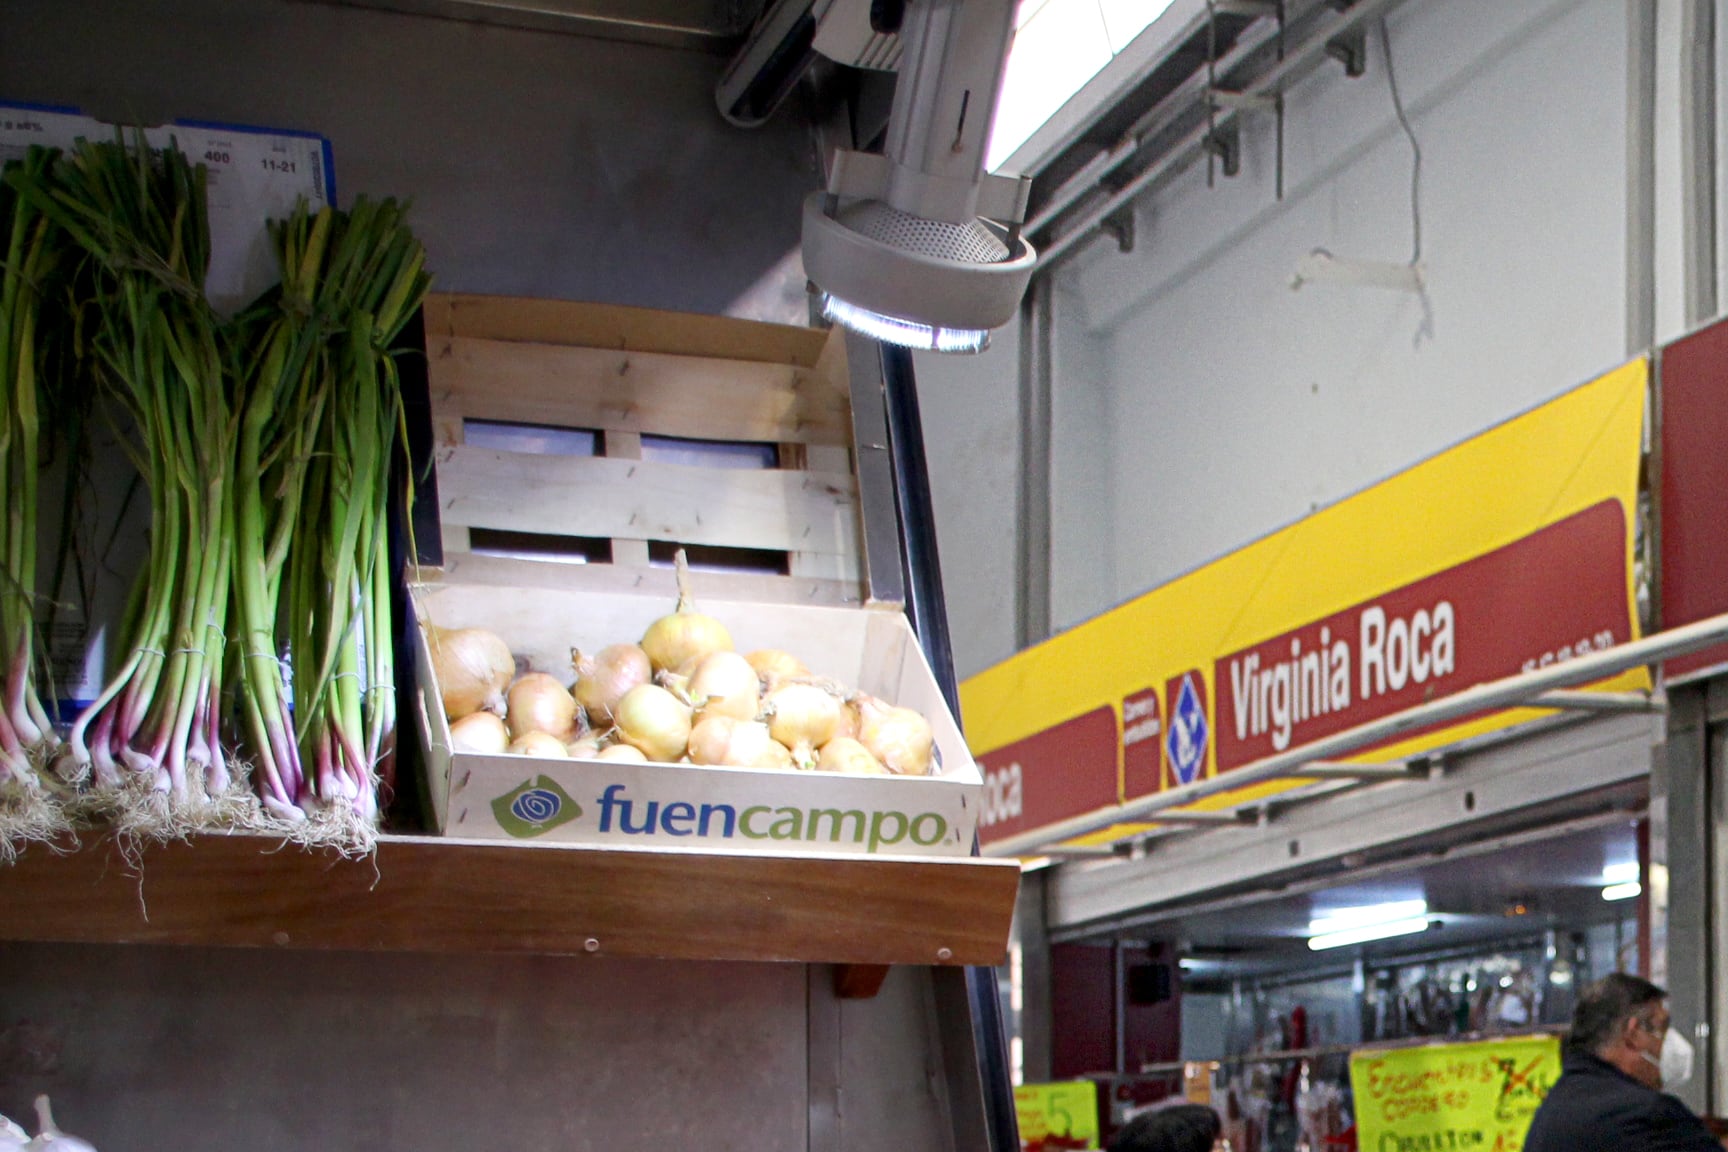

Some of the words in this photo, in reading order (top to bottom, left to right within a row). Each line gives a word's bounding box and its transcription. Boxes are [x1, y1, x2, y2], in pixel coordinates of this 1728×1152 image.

[204, 151, 230, 164] 400
[261, 158, 296, 173] 11-21
[1230, 626, 1350, 750] Virginia
[1360, 601, 1454, 699] Roca
[596, 784, 948, 854] fuencampo
